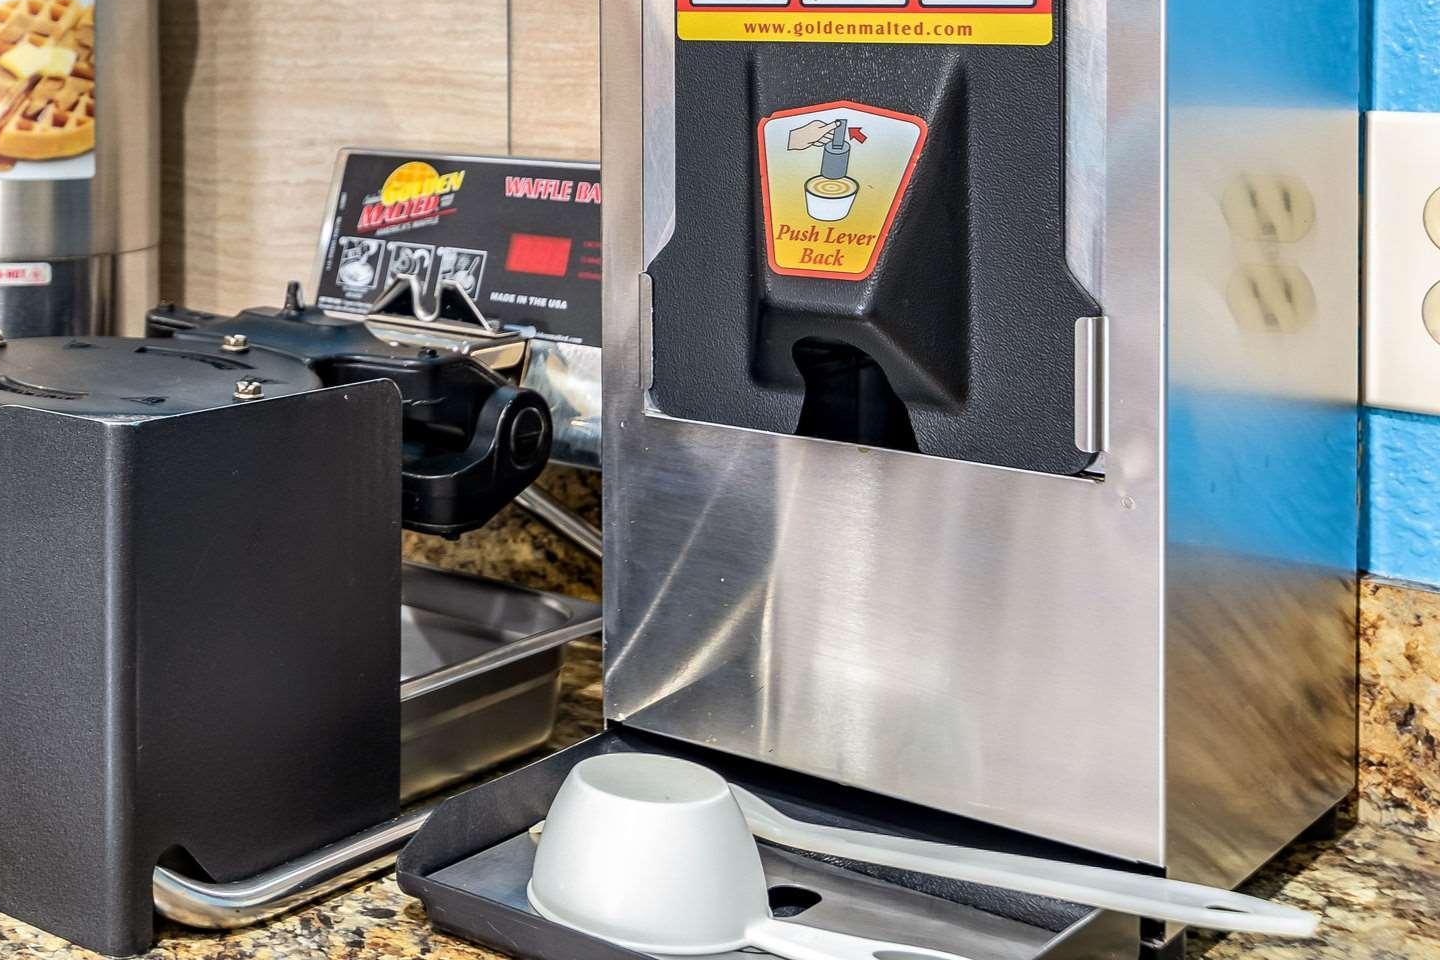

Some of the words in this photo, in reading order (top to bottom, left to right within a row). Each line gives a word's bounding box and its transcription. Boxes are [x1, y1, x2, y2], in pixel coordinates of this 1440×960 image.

[743, 19, 973, 38] www.goldenmalted.com
[505, 176, 573, 200] WAFFLE
[776, 224, 819, 242] Push
[824, 227, 876, 246] Lever
[800, 248, 845, 266] Back
[490, 292, 516, 303] MADE
[516, 294, 528, 305] IN
[529, 296, 548, 308] THE
[548, 299, 568, 310] USA
